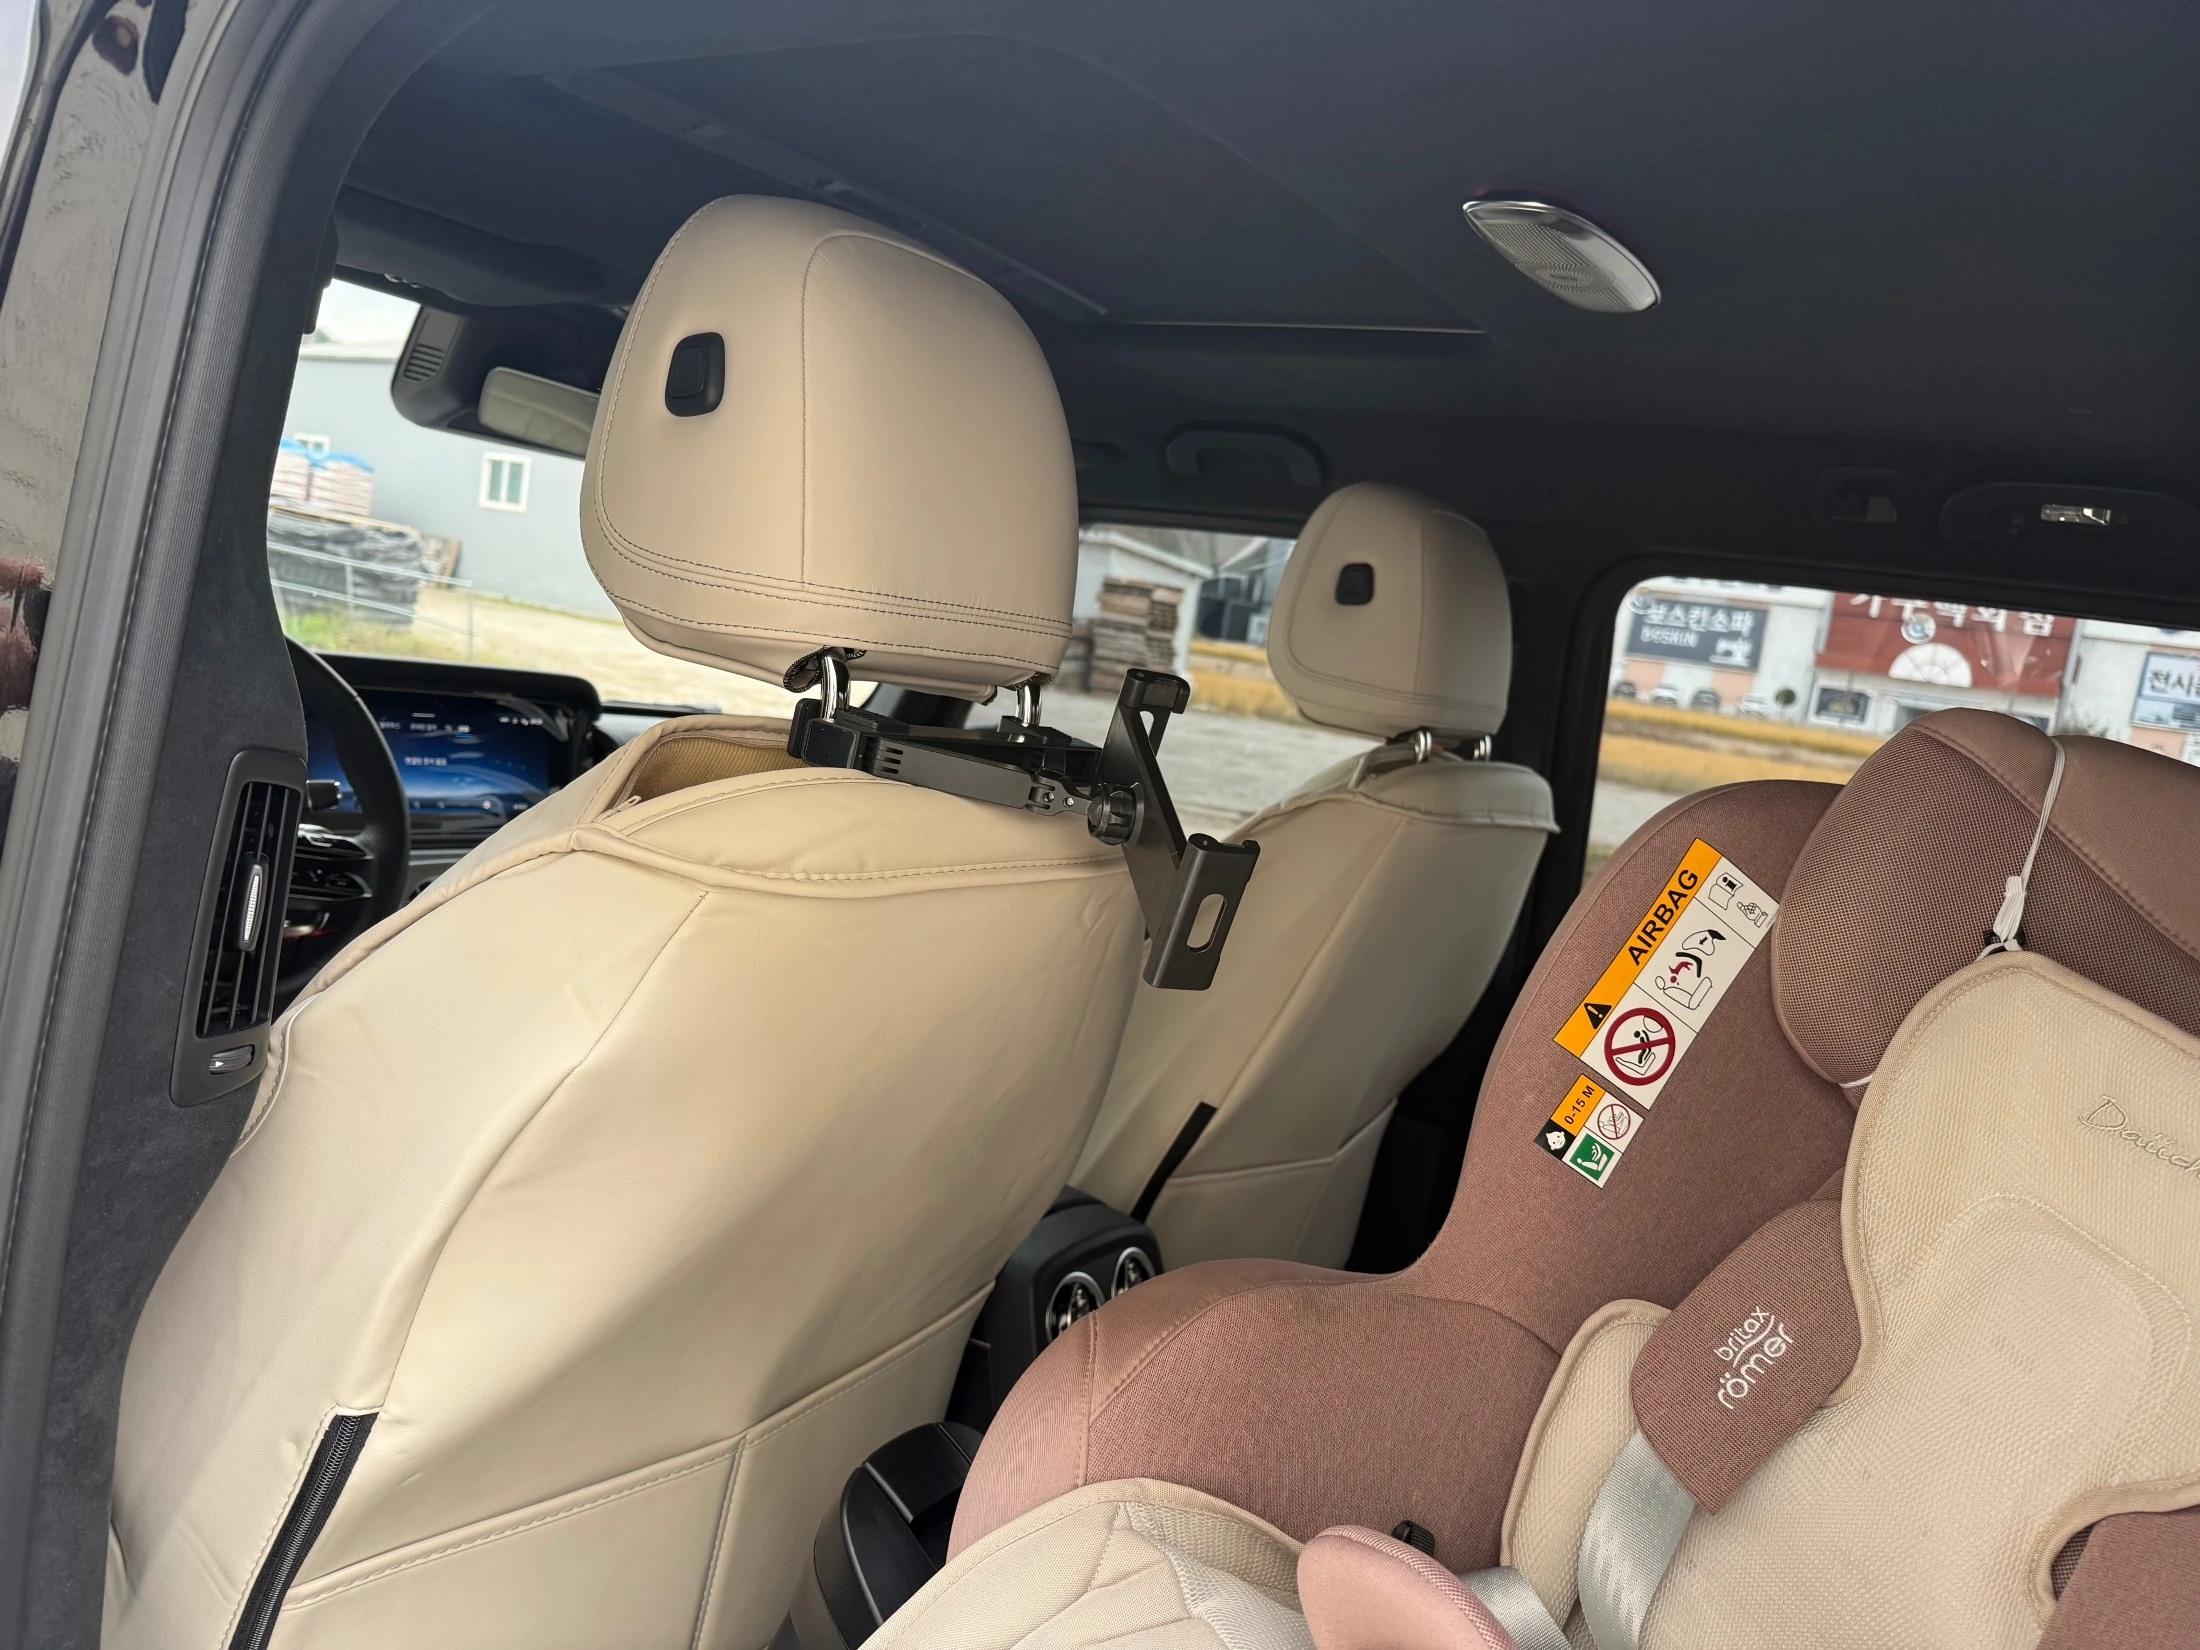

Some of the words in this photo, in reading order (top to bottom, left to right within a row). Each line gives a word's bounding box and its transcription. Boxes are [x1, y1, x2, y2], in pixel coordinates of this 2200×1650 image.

[1627, 868, 1699, 967] AIRBAG
[1563, 1097, 1586, 1126] 0-15
[1582, 1084, 1596, 1099] M
[1713, 1305, 1770, 1361] britax
[1717, 1323, 1794, 1410] römer
